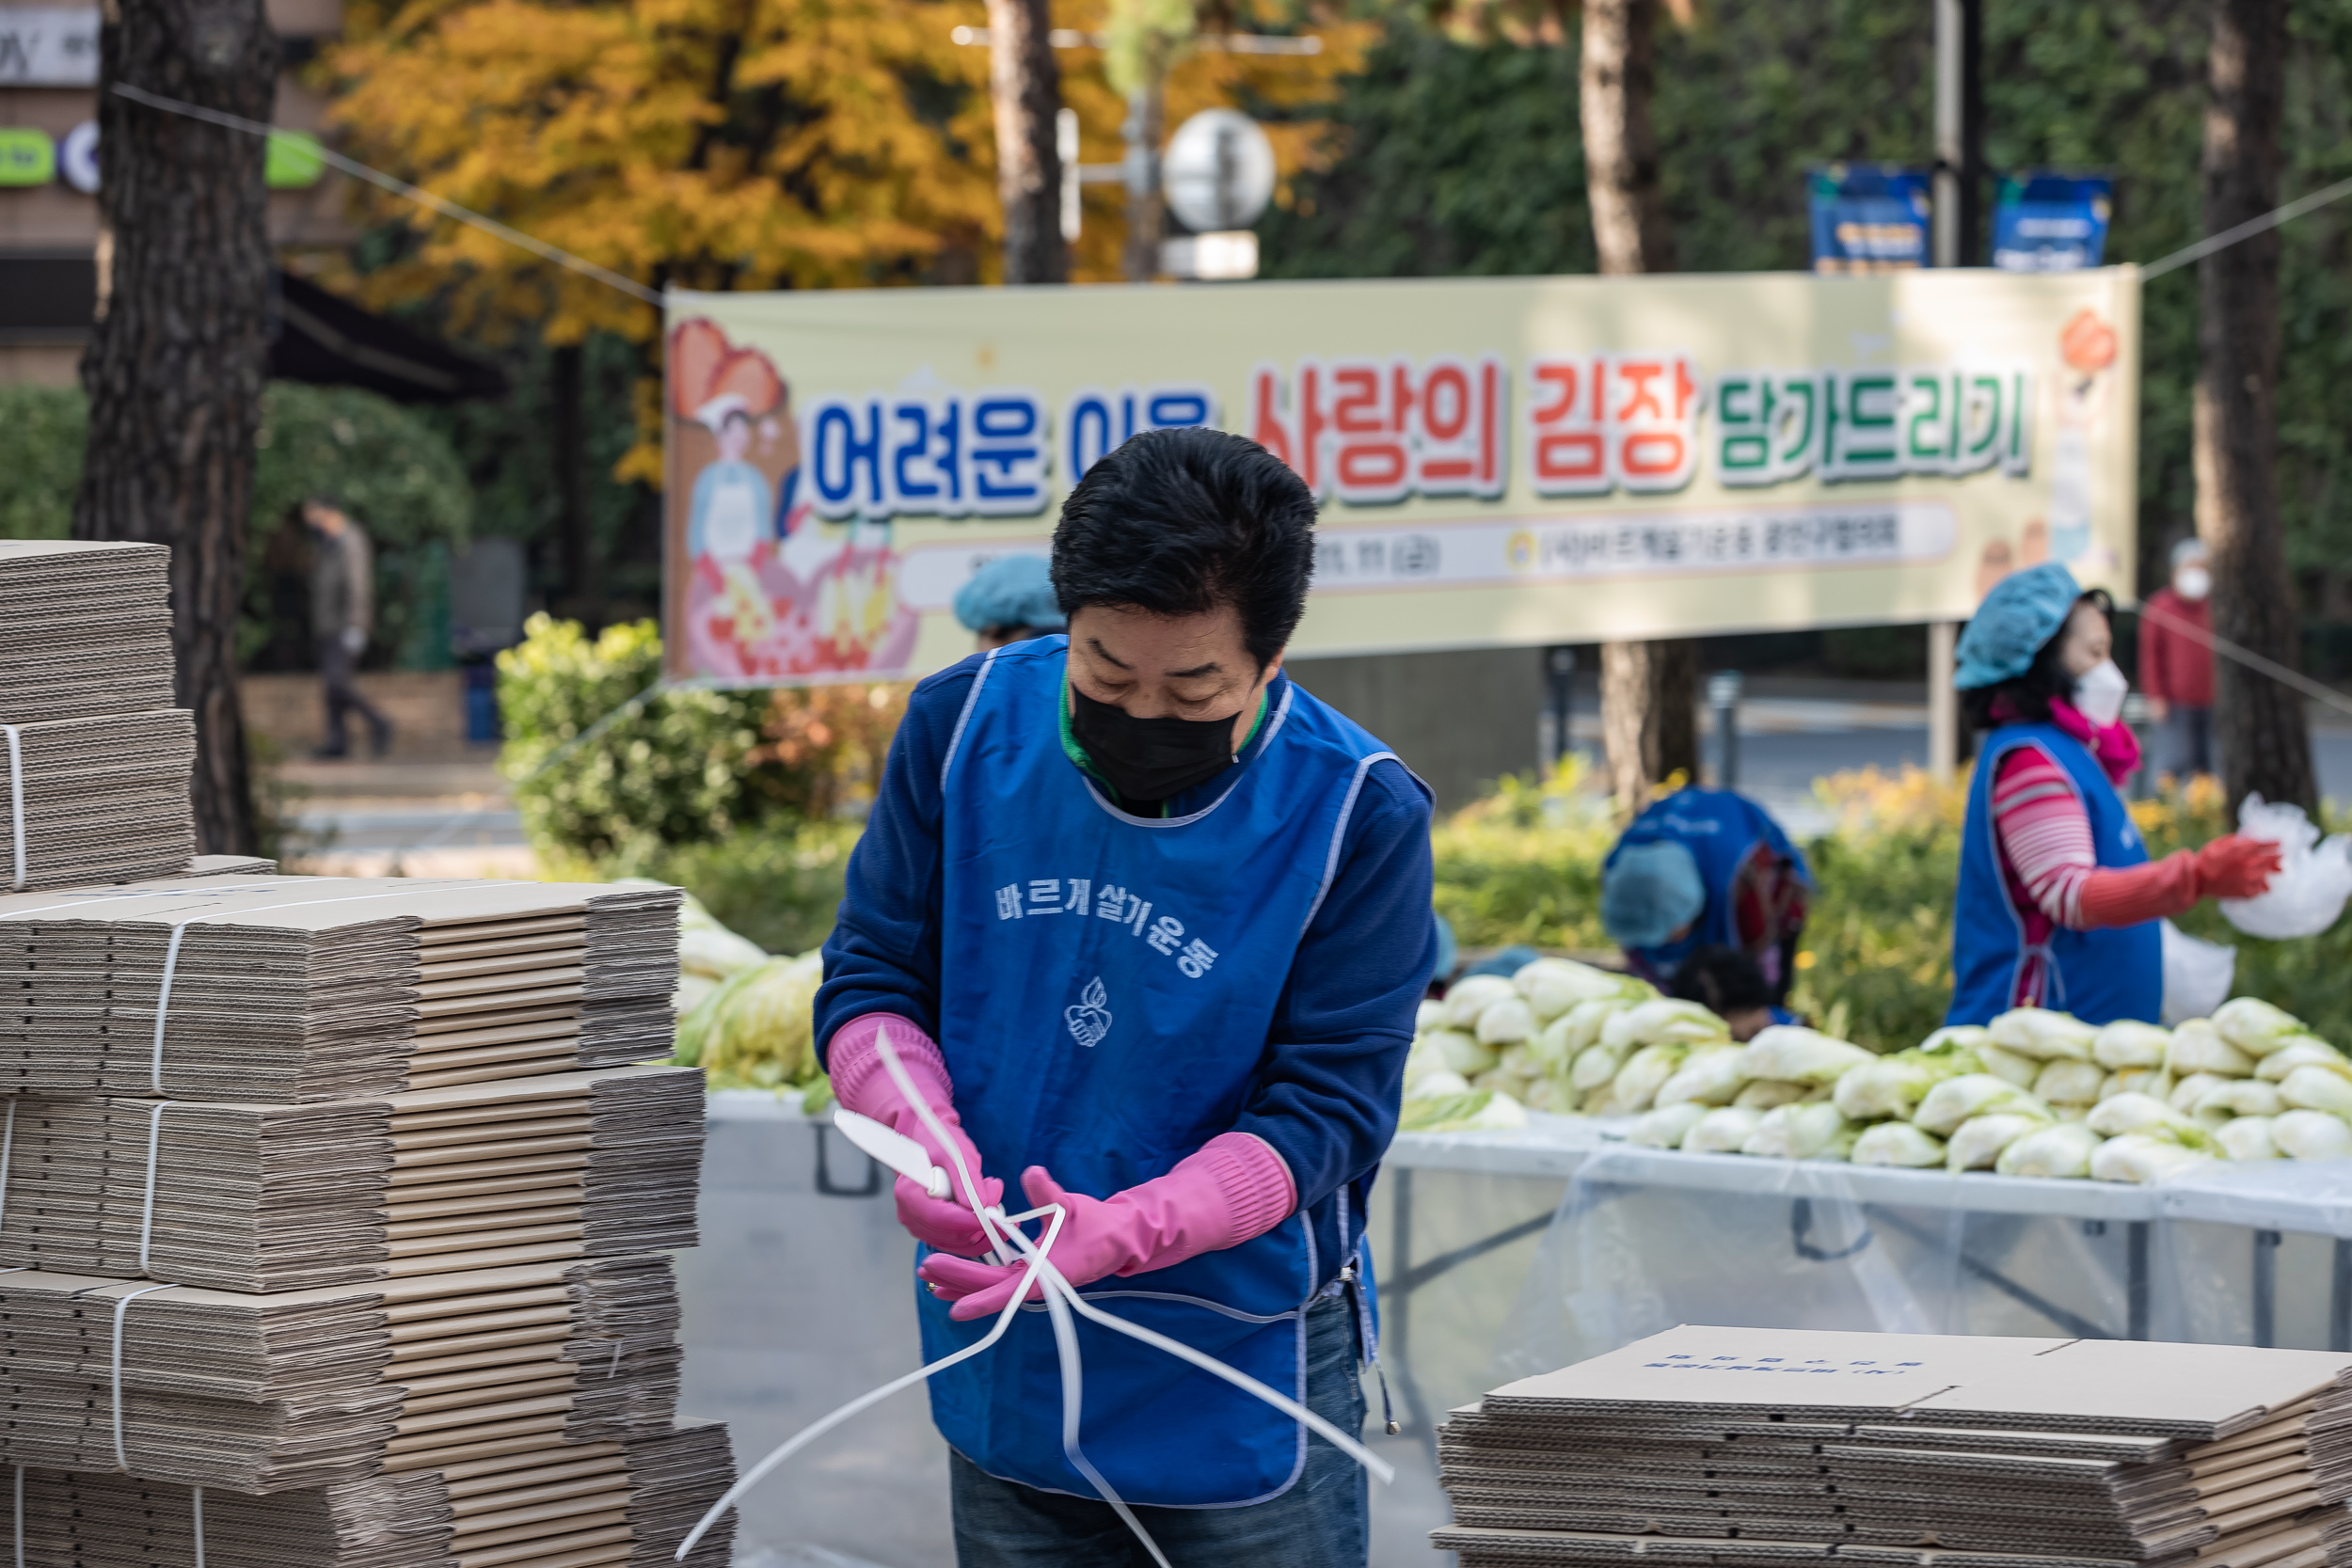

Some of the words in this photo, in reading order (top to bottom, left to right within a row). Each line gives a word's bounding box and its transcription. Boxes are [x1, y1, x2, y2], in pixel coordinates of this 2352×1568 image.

[811, 396, 1041, 505] 어려운
[1253, 358, 1499, 490] 사랑의
[1532, 357, 1695, 480] 김장
[1718, 372, 2025, 471] 담가드리기
[994, 878, 1219, 979] 바르게살기운동
